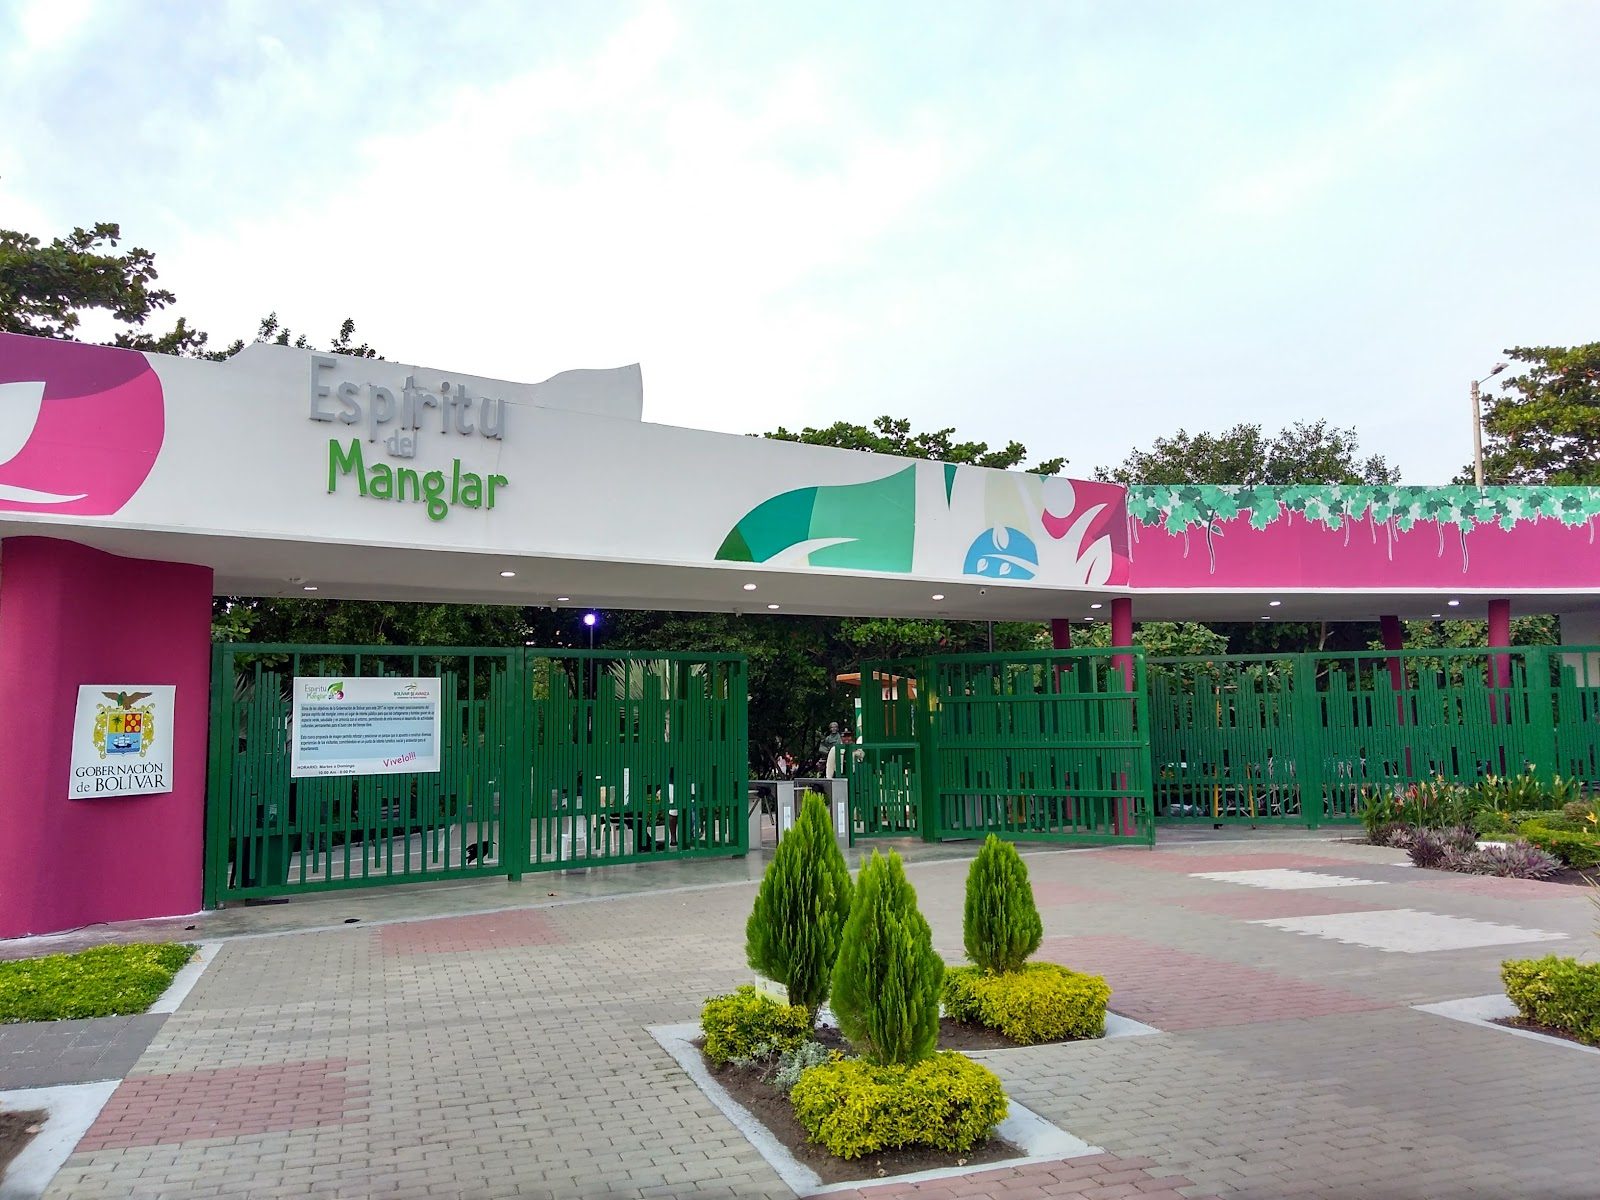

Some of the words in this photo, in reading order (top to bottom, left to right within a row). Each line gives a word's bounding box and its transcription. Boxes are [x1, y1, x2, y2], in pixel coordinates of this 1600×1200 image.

[387, 430, 417, 458] del
[328, 438, 508, 521] Manglar
[76, 762, 163, 778] GOBERNACIÓN
[76, 782, 90, 792] de
[96, 774, 166, 792] BOLÍVAR
